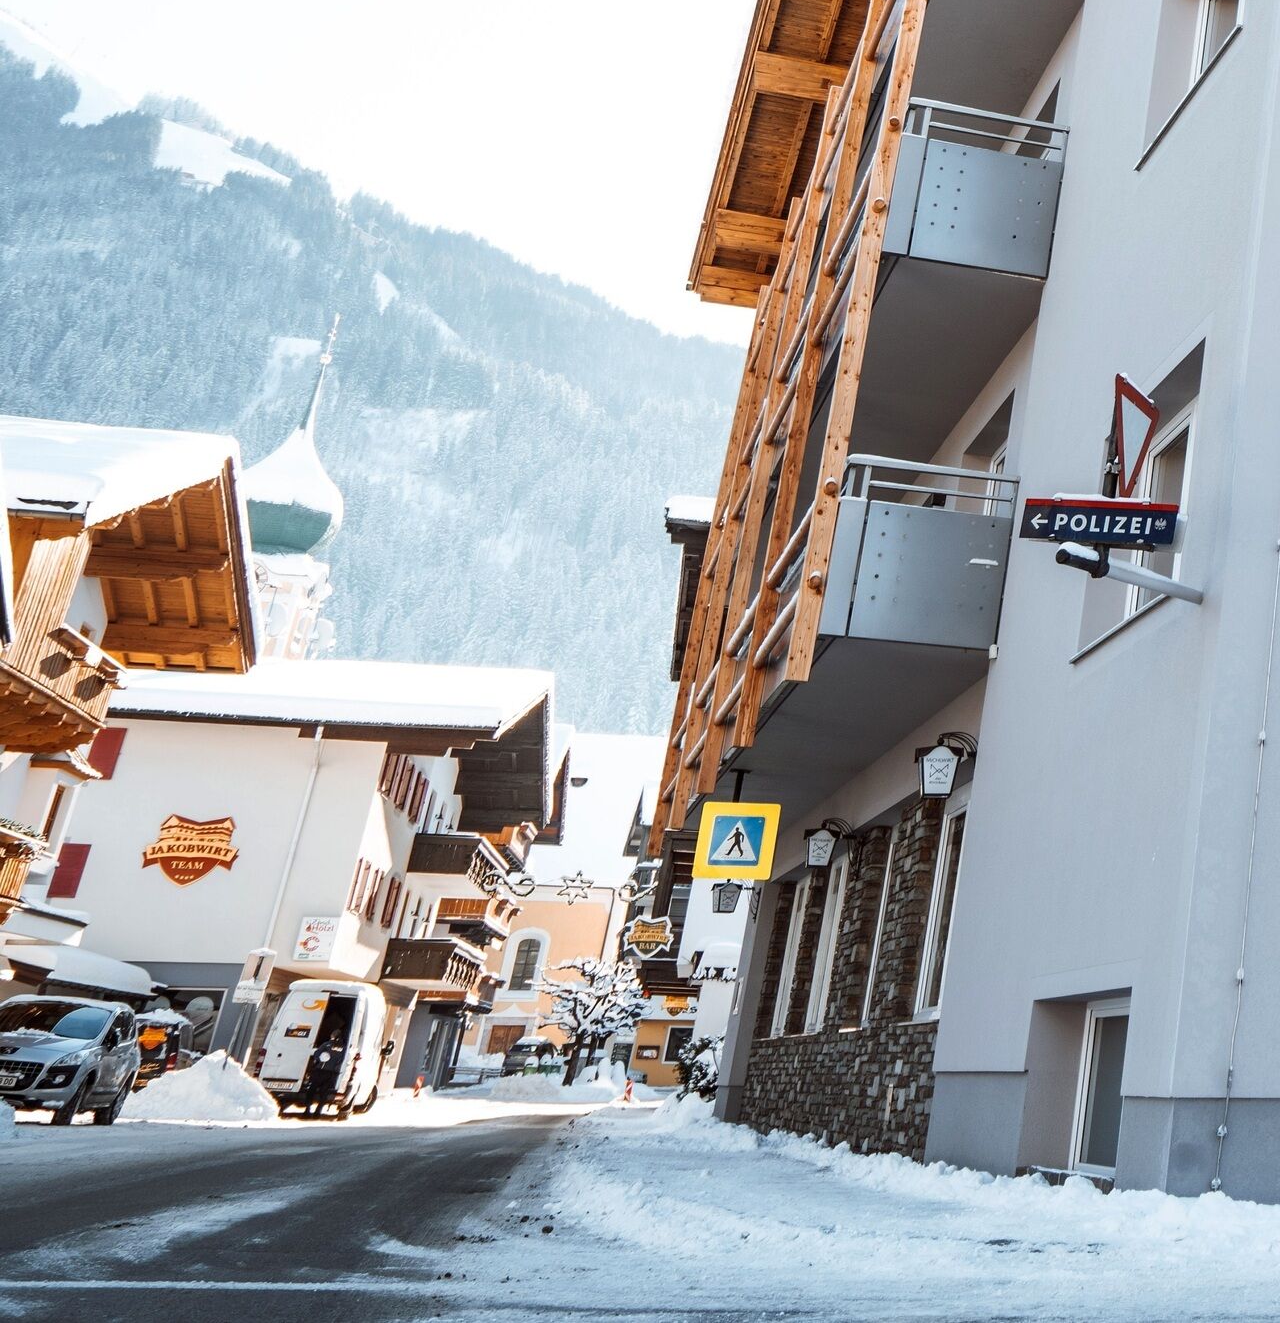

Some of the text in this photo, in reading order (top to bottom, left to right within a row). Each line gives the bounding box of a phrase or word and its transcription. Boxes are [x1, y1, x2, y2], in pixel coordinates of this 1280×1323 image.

[1054, 513, 1152, 535] POLIZEI
[149, 844, 232, 858] JAKOBWIRT
[170, 861, 204, 870] TEAM
[638, 942, 656, 950] BAR
